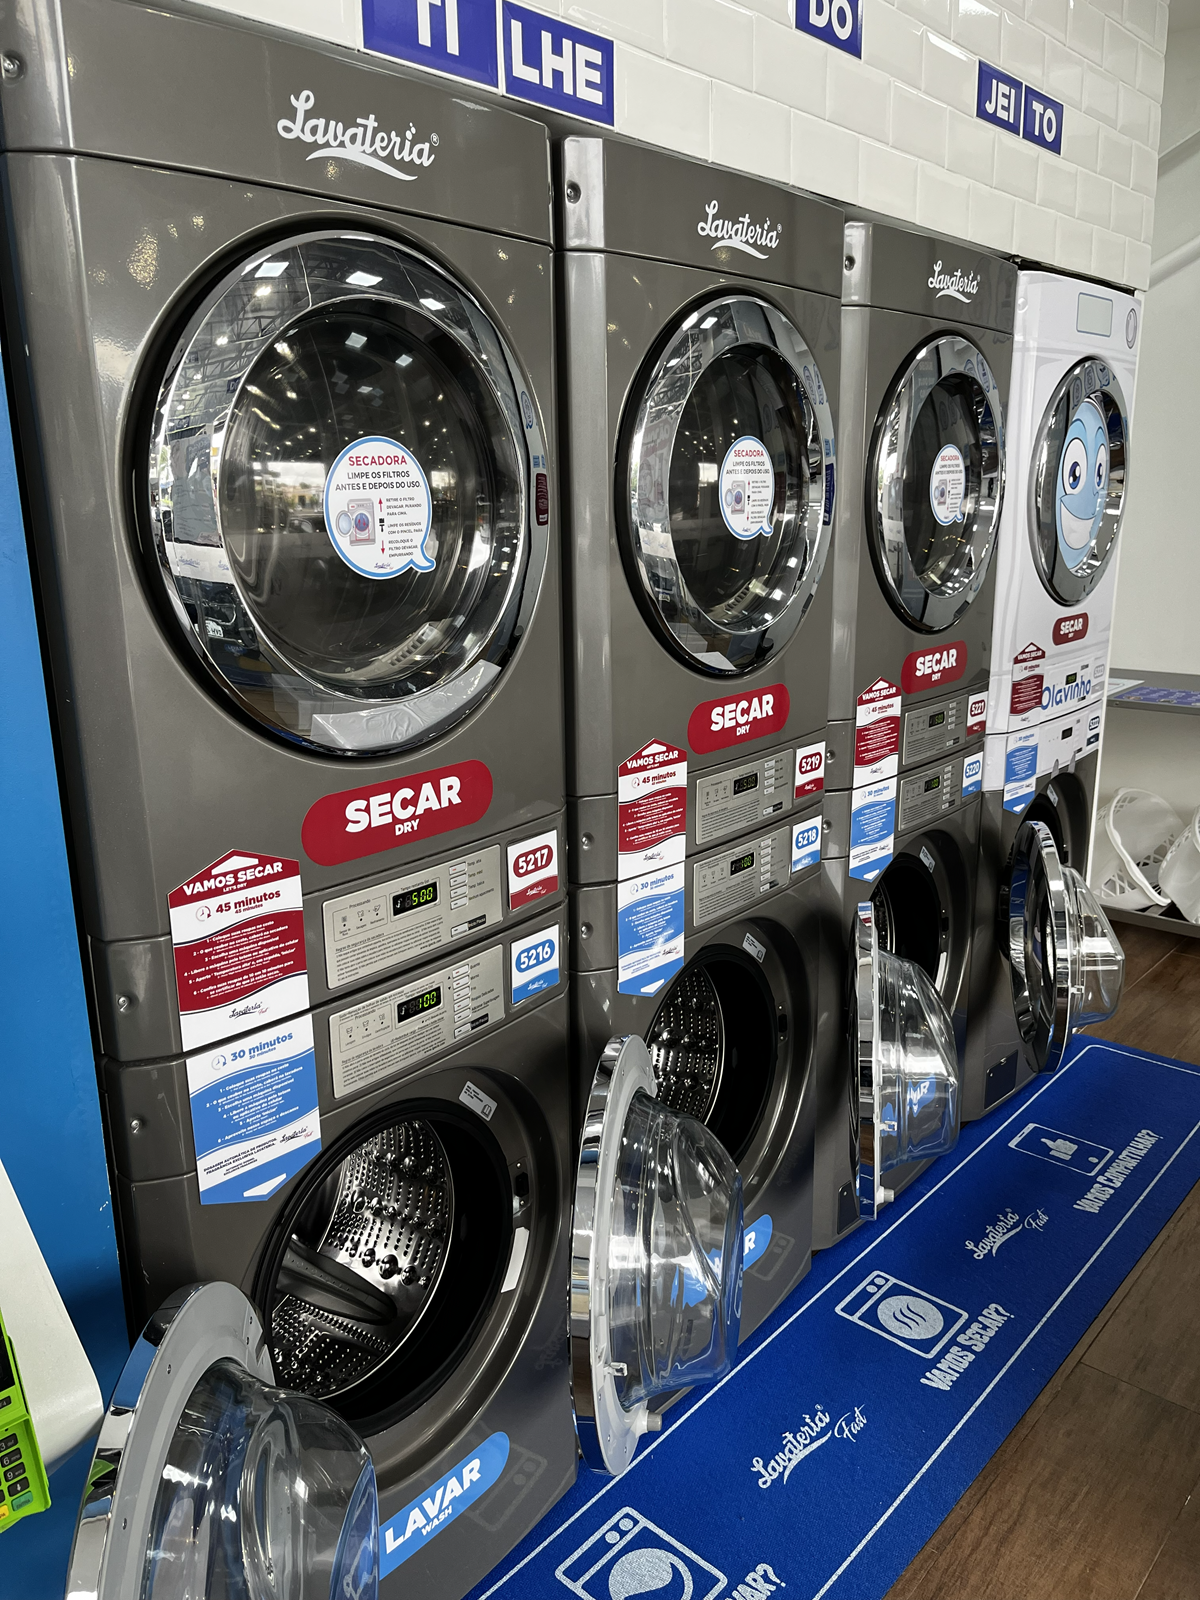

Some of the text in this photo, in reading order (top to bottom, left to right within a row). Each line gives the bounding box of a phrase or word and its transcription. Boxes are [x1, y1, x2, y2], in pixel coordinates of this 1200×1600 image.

[809, 0, 853, 40] DO
[511, 19, 603, 105] LHE
[985, 79, 1015, 124] JEI
[1032, 100, 1057, 142] TO
[348, 455, 407, 467] SECADORA
[734, 450, 764, 458] SECADORA
[348, 470, 410, 480] LIMPE OS FILTROS
[335, 483, 361, 492] ANTES
[368, 482, 394, 490] DEPOIS
[396, 482, 406, 490] DO
[406, 481, 421, 489] USO.
[1060, 618, 1083, 635] SECAR
[916, 649, 957, 677] SECAR
[932, 672, 941, 681] DRY
[862, 686, 896, 700] VAMOS SECAR
[1041, 676, 1092, 710] Olavinho
[710, 694, 774, 732] SECAR
[878, 703, 894, 712] minutos
[736, 725, 750, 736] DRY
[626, 750, 679, 770] VAMOS SECAR
[800, 754, 821, 772] 5219
[642, 770, 677, 784] 45 minutos
[344, 776, 462, 833] SECAR
[395, 820, 420, 836] DRY
[797, 829, 817, 846] 5218
[518, 848, 549, 873] 5217
[183, 862, 283, 896] VAMOS SECAR
[640, 874, 674, 890] 30 minutos
[215, 890, 280, 912] 45 minutos
[412, 887, 432, 905] 500
[520, 944, 552, 969] 5216
[419, 991, 436, 1008] 100
[231, 1032, 292, 1061] 30 minutos
[1073, 1129, 1164, 1214] VAMOS COMPARTILHAR?
[1024, 1208, 1050, 1232] Fast
[920, 1303, 1015, 1390] VAMOS SECAR?
[834, 1403, 868, 1443] Fast
[6, 1471, 14, 1480] 9
[385, 1458, 482, 1554] LAVAR
[422, 1505, 452, 1536] WASH
